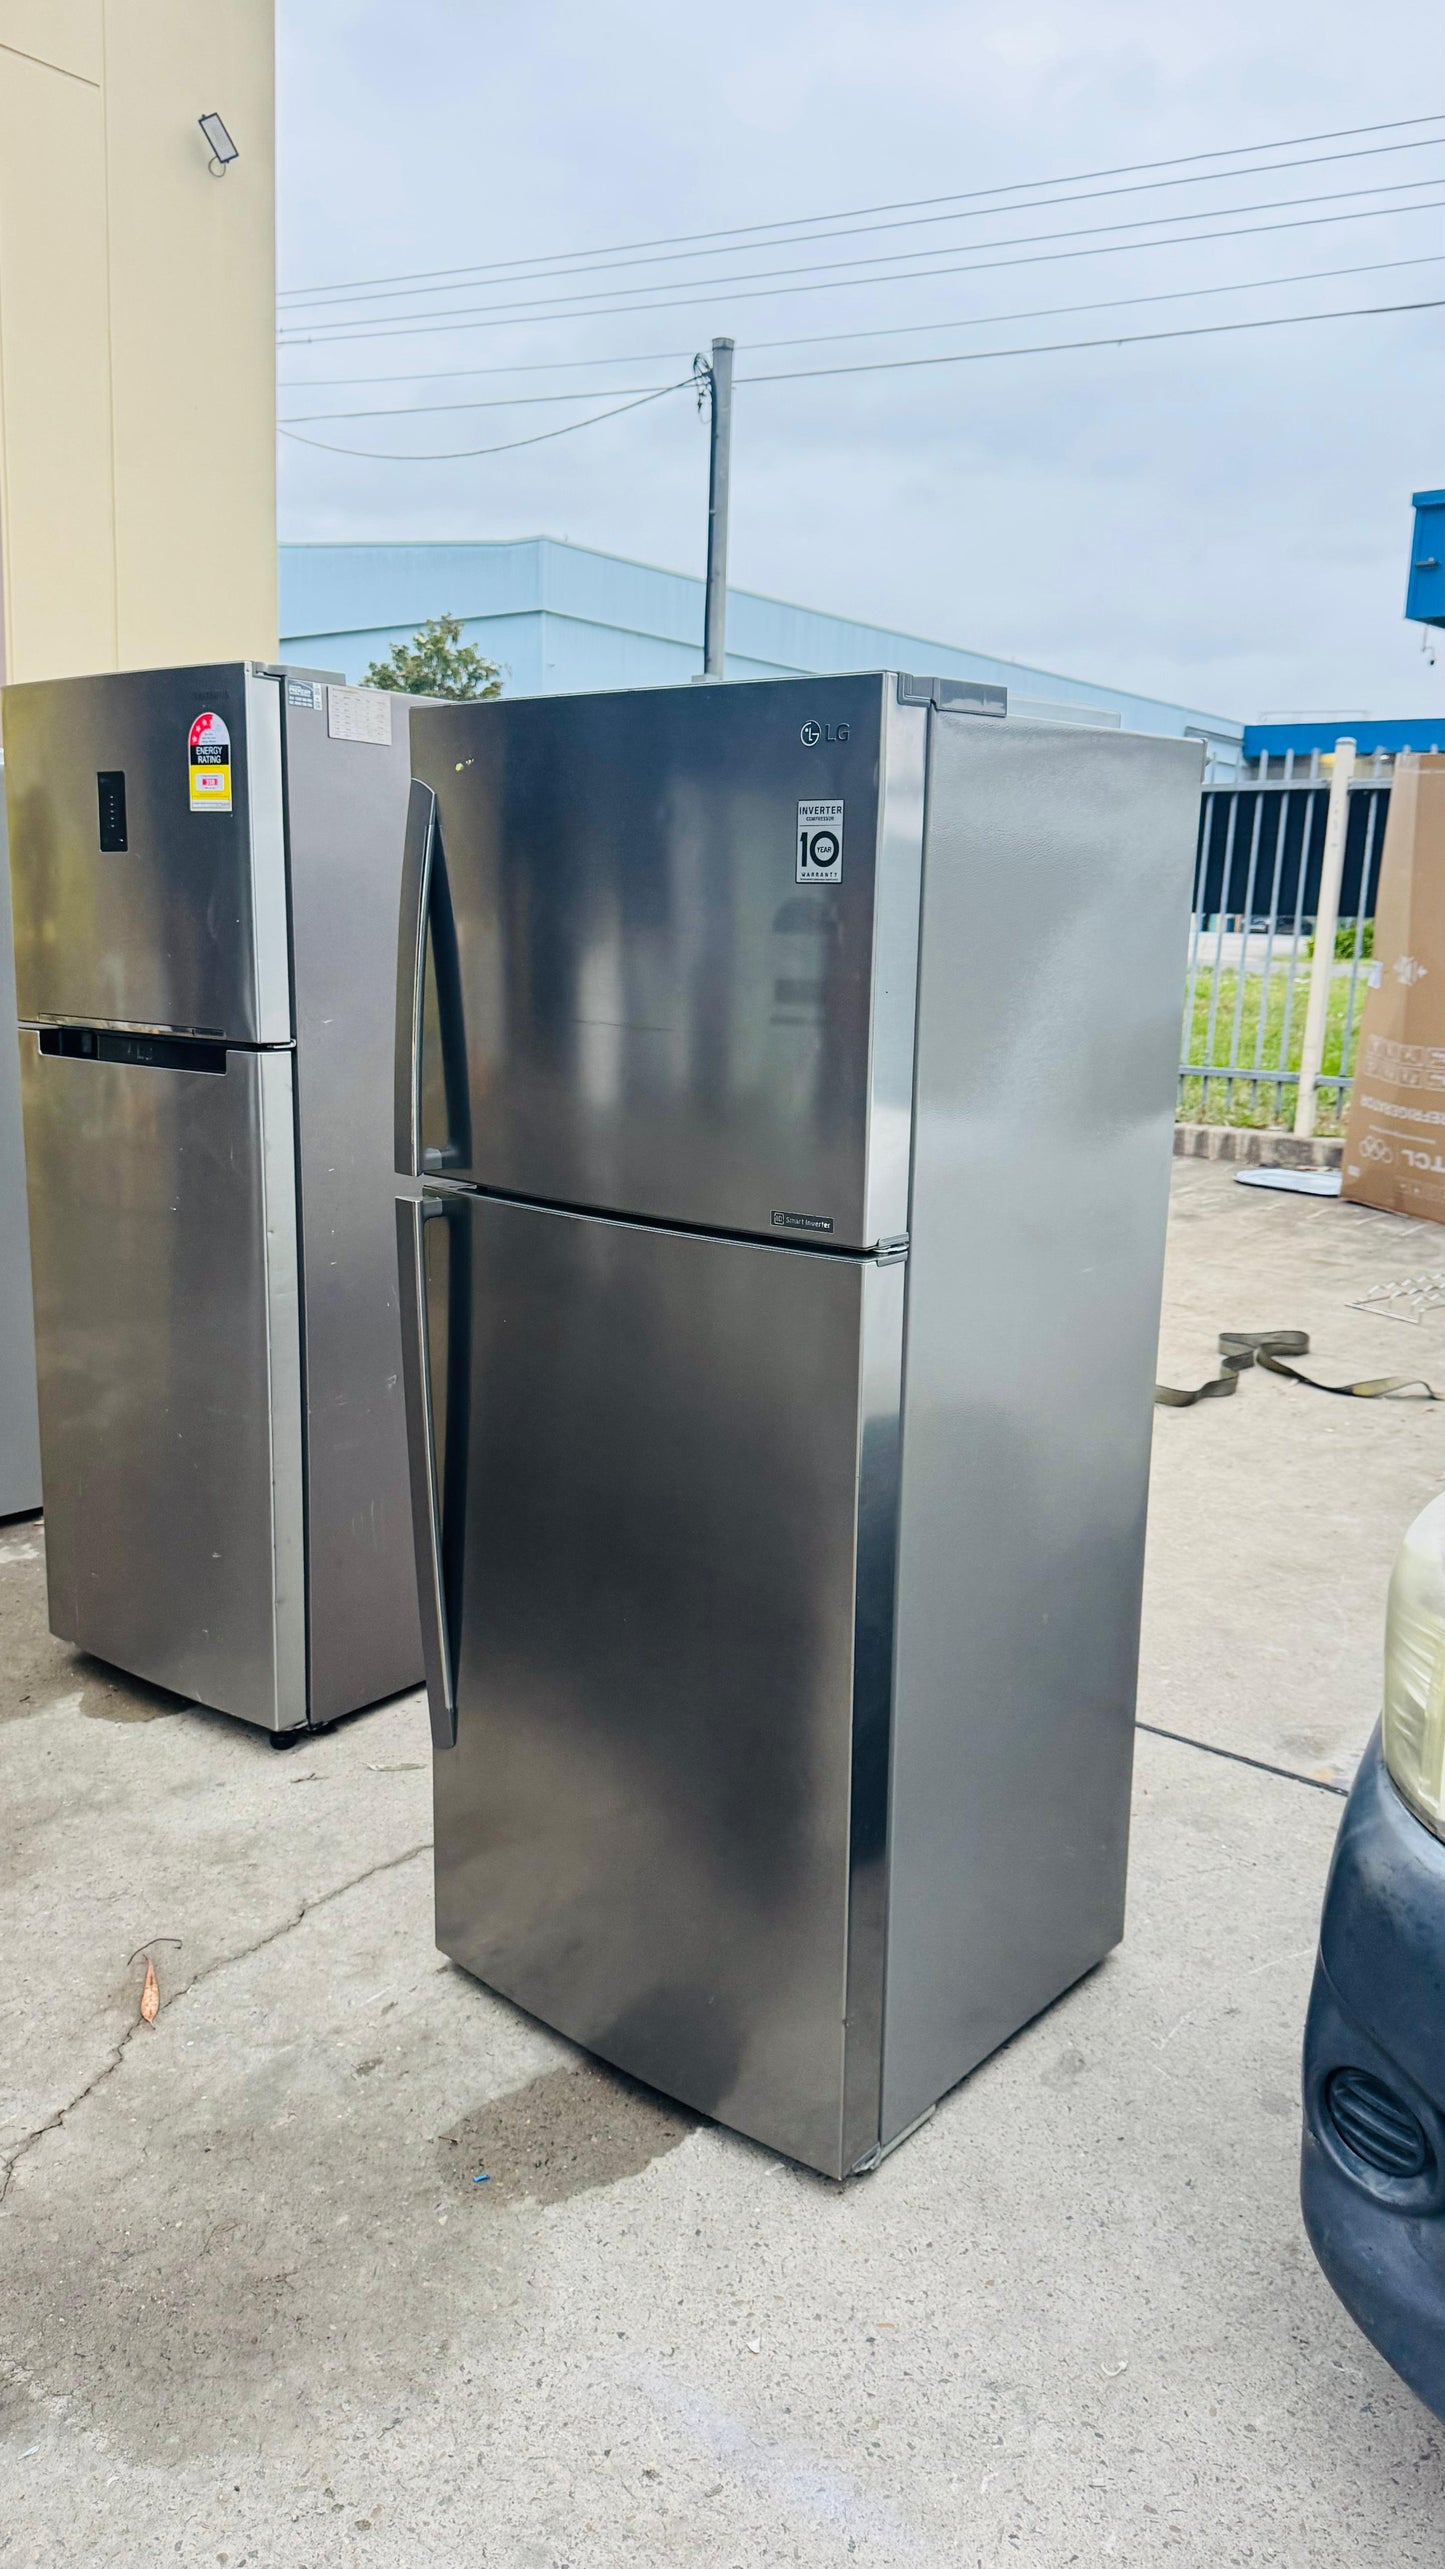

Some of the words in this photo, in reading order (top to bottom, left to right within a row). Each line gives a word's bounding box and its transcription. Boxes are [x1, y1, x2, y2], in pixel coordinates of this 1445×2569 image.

[825, 722, 850, 741] LG
[196, 746, 223, 755] ENERGY
[197, 756, 222, 764] RATING
[799, 805, 842, 815] INVERTER
[799, 830, 840, 868] 10
[1402, 1149, 1445, 1173] TCL
[785, 1216, 804, 1225] Smart
[805, 1219, 830, 1229] Inverter
